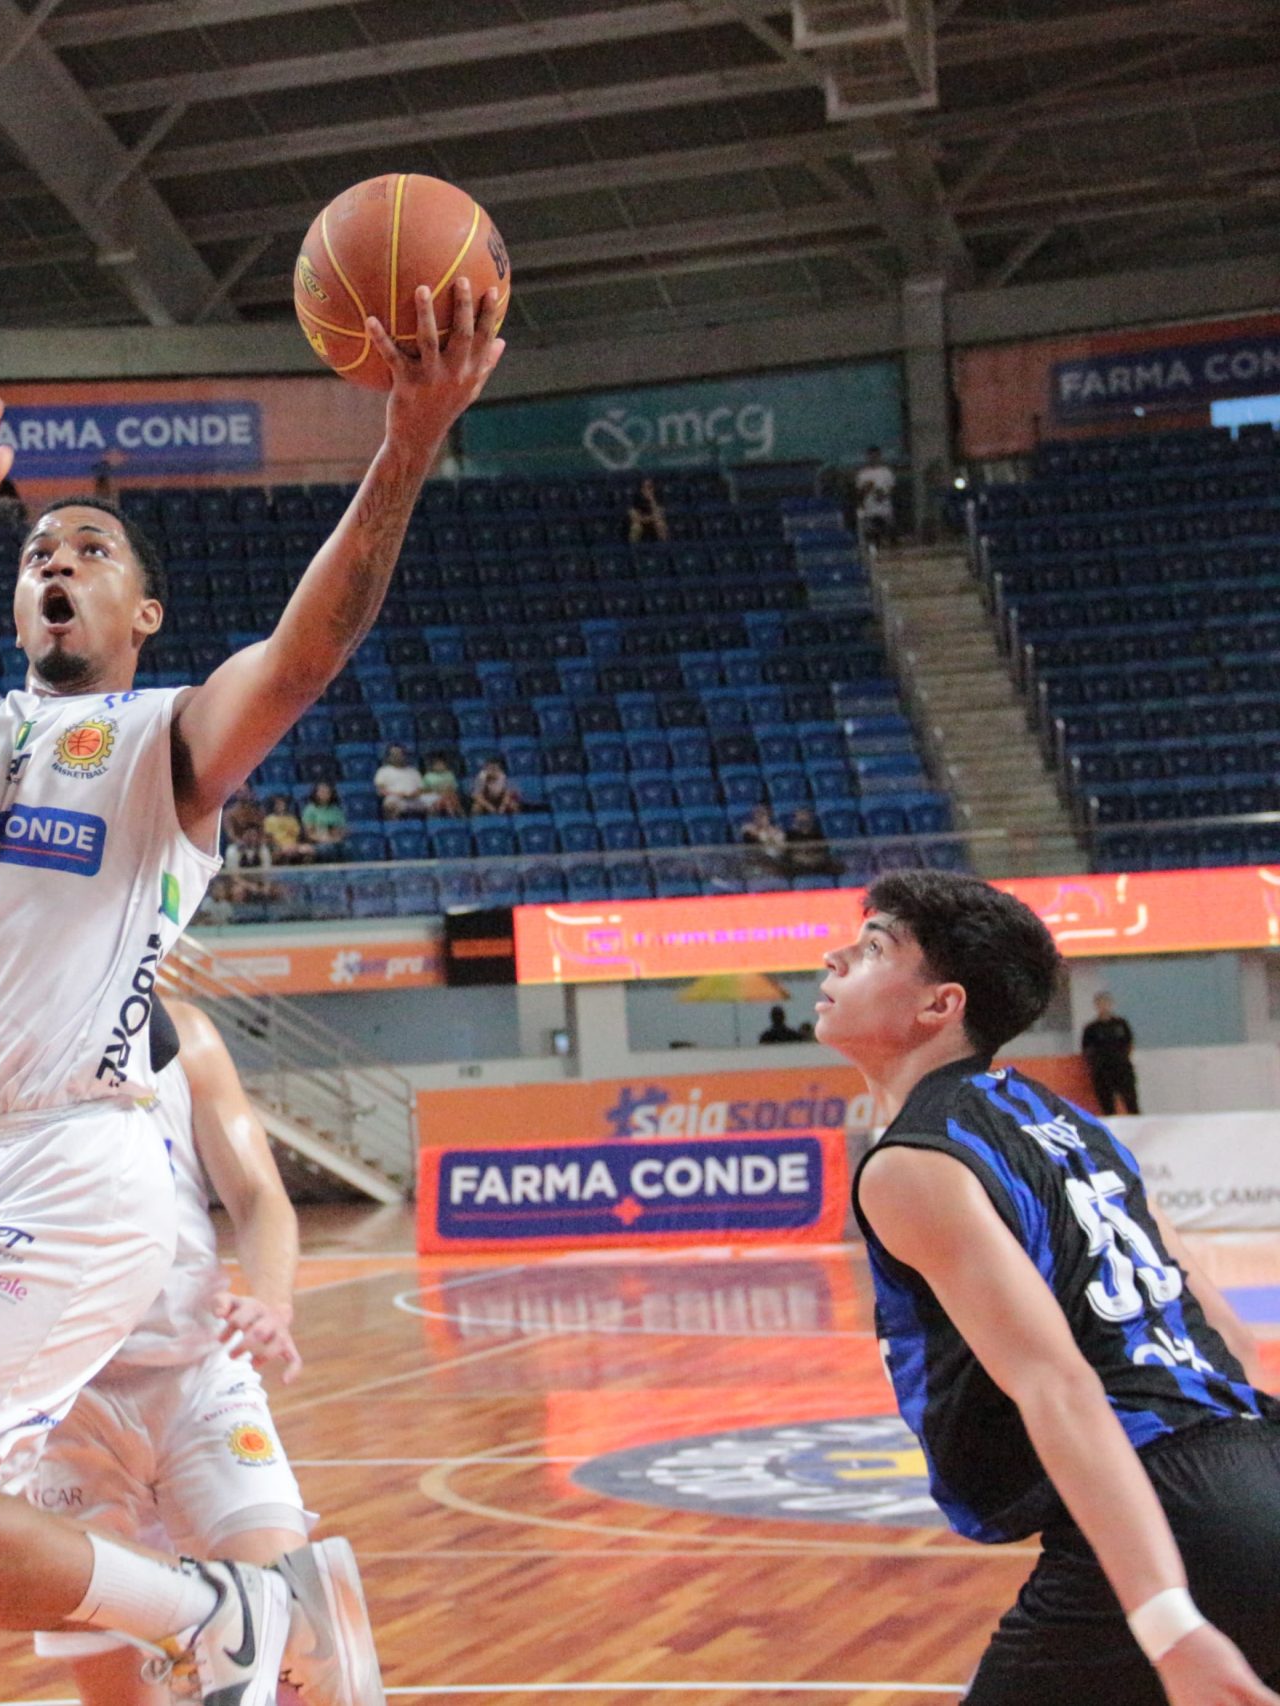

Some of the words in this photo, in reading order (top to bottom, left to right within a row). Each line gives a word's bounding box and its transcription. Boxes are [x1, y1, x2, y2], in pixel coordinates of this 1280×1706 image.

[1060, 358, 1193, 400] FARMA
[116, 413, 253, 449] CONDE
[658, 404, 775, 459] mcg
[51, 762, 109, 780] BASKETBALL
[4, 814, 97, 852] ONDE
[450, 1160, 618, 1205] FARMA
[630, 1153, 809, 1198] CONDE
